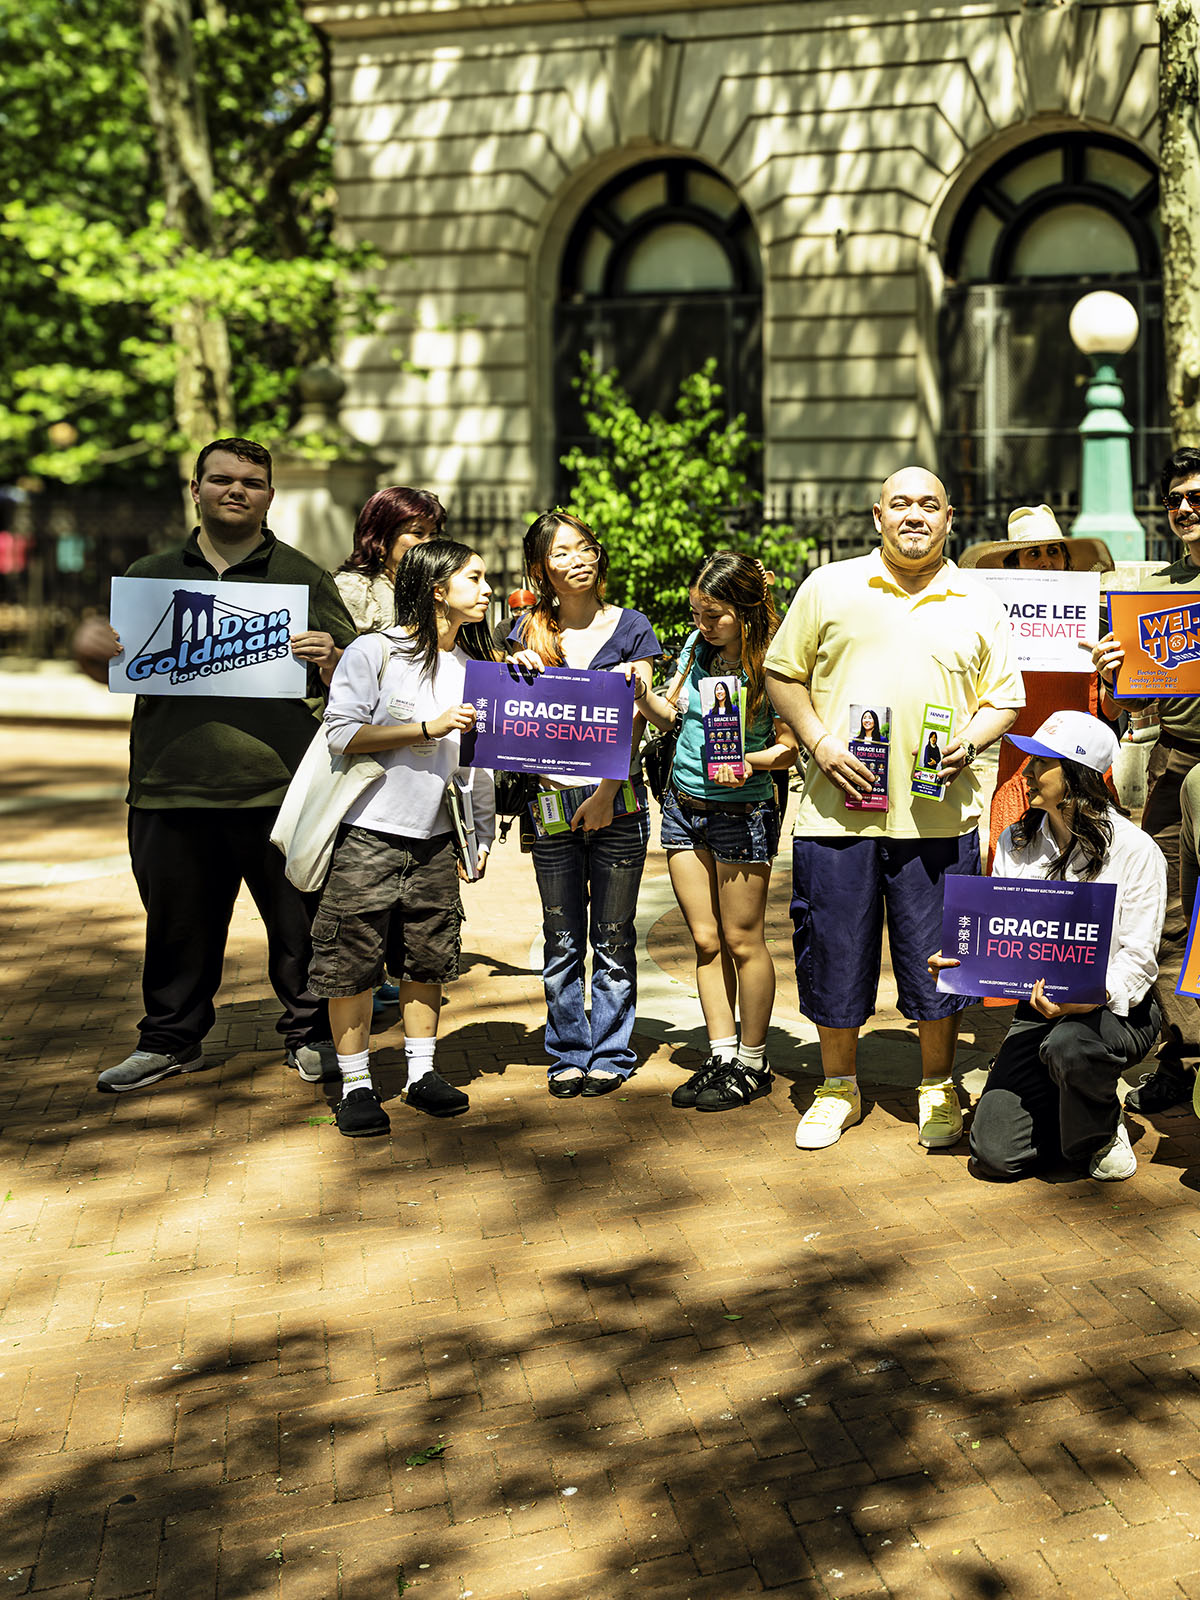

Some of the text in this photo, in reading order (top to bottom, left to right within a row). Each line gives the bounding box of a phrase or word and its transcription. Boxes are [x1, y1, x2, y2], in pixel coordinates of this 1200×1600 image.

[1003, 603, 1087, 620] ACE LEE
[218, 609, 291, 641] Dan
[1020, 622, 1086, 639] SENATE
[127, 627, 290, 680] Goldman
[1172, 640, 1181, 648] 65
[170, 645, 289, 684] for CONGRESS
[504, 699, 620, 725] GRACE LEE
[502, 719, 618, 744] FOR SENATE
[857, 745, 875, 753] GRACE
[957, 915, 971, 955] 李榮恩
[988, 917, 1100, 942] GRACE LEE
[986, 939, 1097, 965] FOR SENATE
